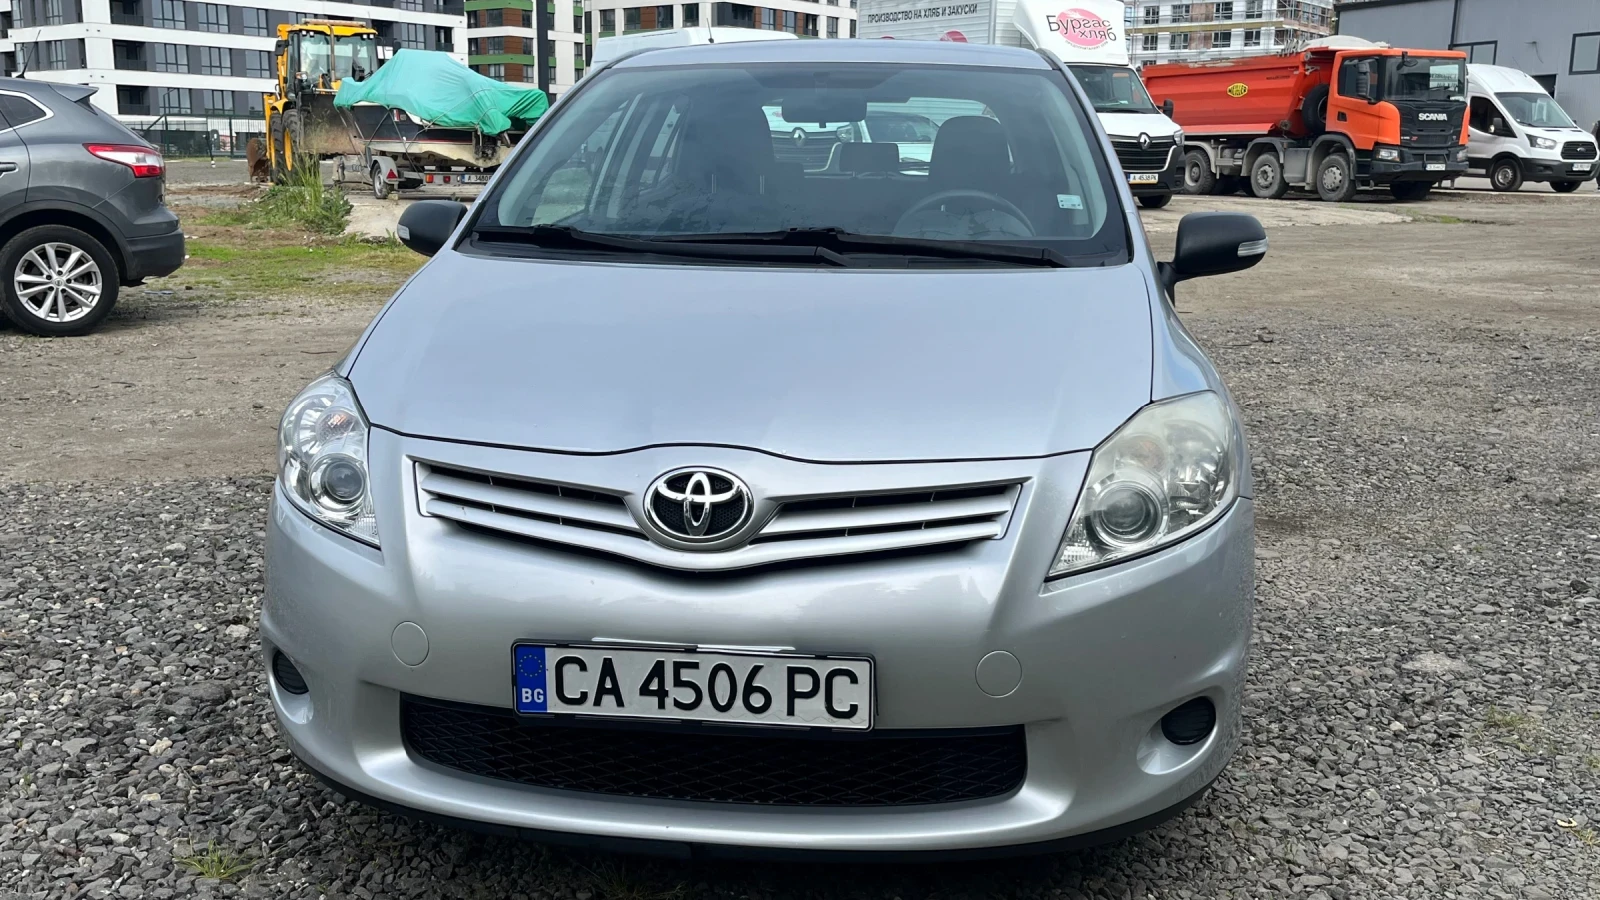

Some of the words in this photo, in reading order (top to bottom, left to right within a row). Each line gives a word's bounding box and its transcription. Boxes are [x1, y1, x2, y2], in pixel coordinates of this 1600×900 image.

[867, 10, 913, 24] ПРОИЗВОДСТВО
[913, 9, 922, 20] НА
[923, 7, 940, 18] ХЛЯБ
[941, 6, 947, 17] И
[947, 3, 978, 16] ЗАКУСКИ
[1046, 15, 1111, 35] Бургас
[1078, 27, 1117, 41] хляб
[1418, 112, 1448, 121] SCANIA
[521, 688, 544, 703] BG
[554, 655, 625, 708] CA
[638, 659, 772, 715] 4506
[786, 665, 859, 719] PC
